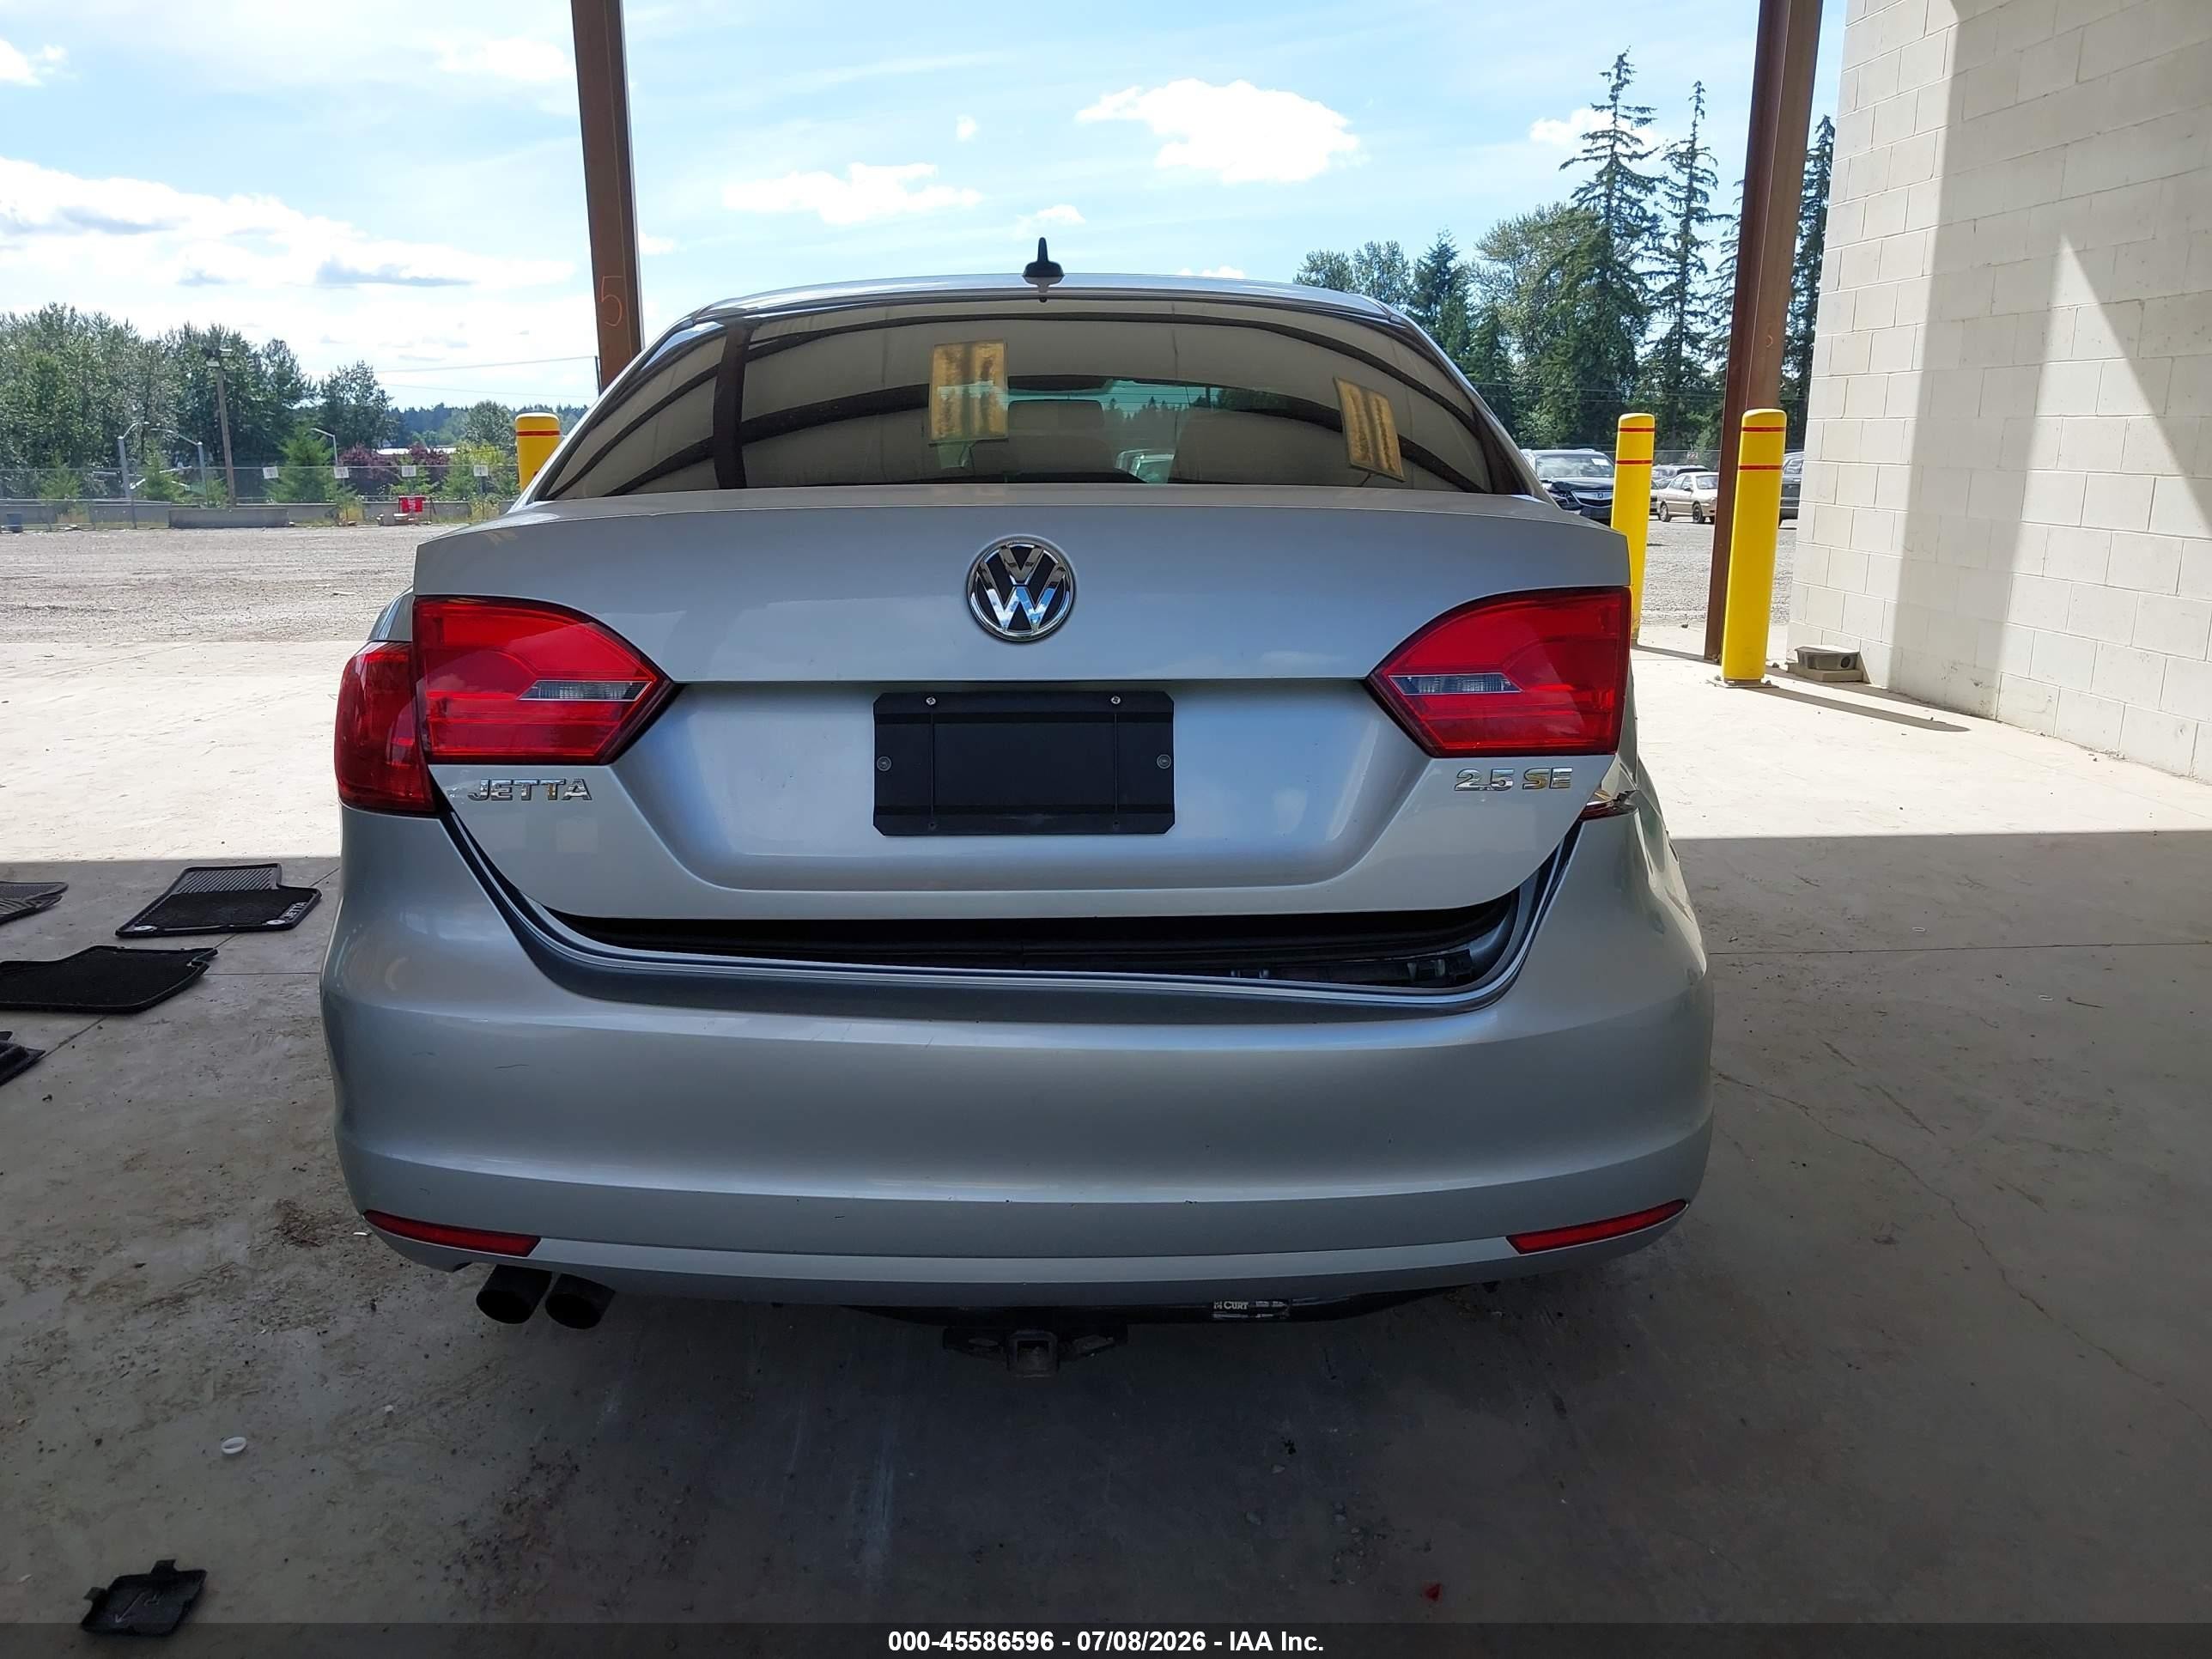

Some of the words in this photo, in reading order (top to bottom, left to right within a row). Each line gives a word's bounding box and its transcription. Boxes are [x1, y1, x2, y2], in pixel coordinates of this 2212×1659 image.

[600, 275, 624, 327] 5
[975, 542, 1067, 634] VW
[1522, 767, 1573, 790] SE
[467, 779, 592, 801] JETTA
[284, 902, 308, 920] JETTA
[1224, 1300, 1249, 1310] CURT
